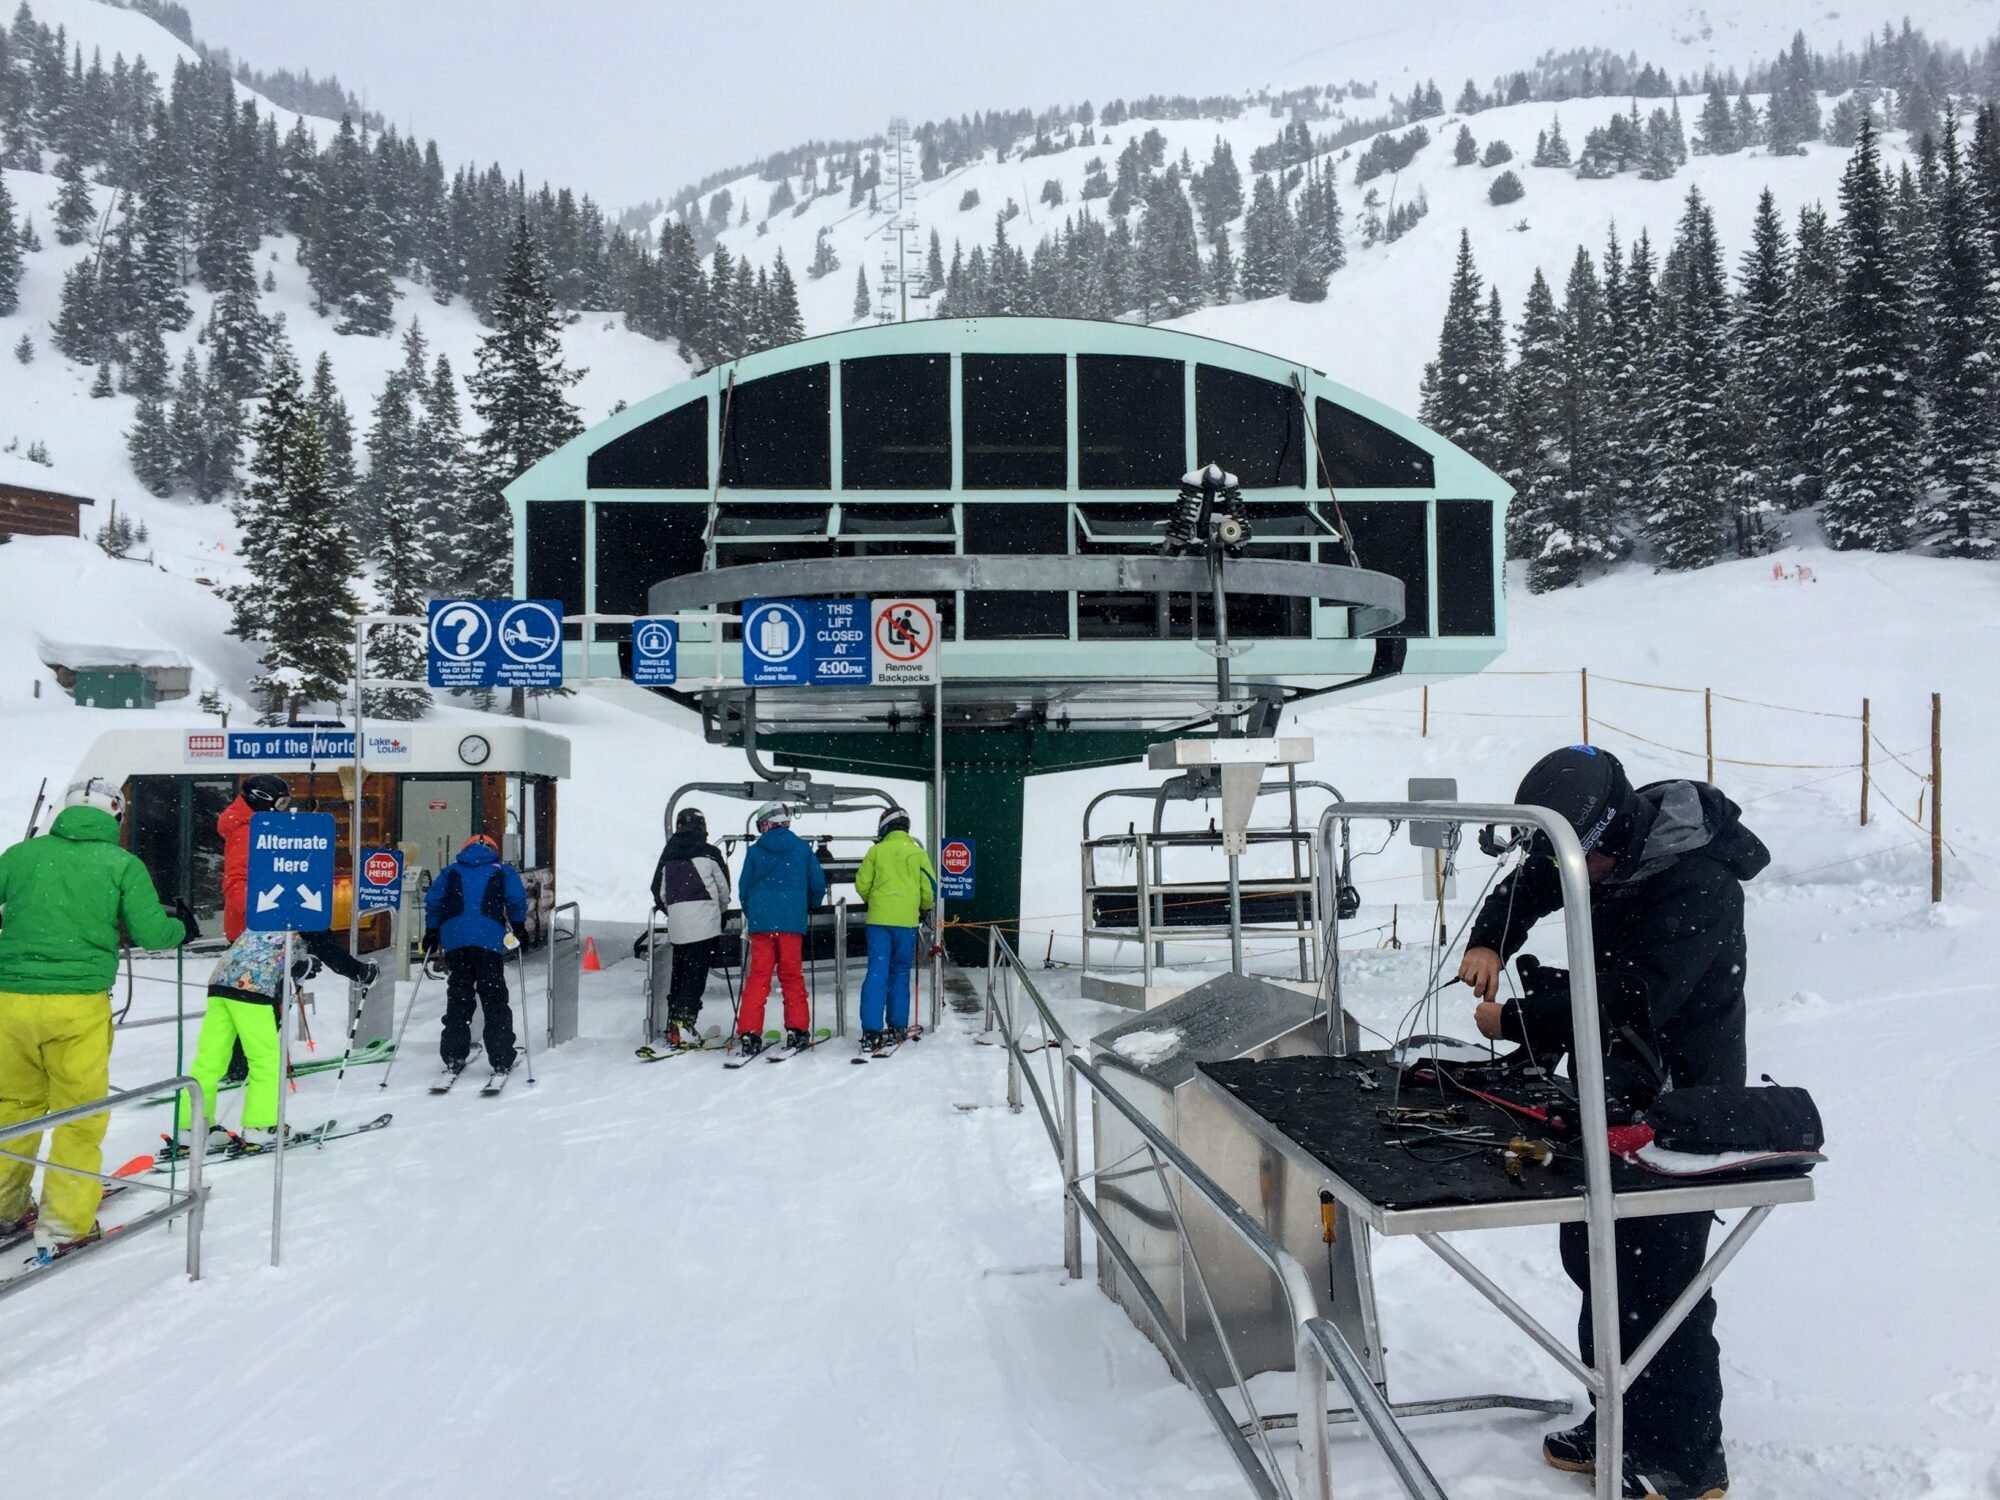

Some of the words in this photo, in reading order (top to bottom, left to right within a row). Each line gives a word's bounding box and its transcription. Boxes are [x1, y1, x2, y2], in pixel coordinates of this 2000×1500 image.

[827, 604, 854, 616] THIS
[828, 617, 852, 628] LIFT
[816, 630, 863, 642] CLOSED
[833, 644, 847, 655] AT
[763, 665, 788, 673] Secure
[885, 663, 923, 672] Remove
[754, 673, 777, 682] Loose
[777, 673, 797, 682] Items
[878, 673, 930, 684] Backpacks
[369, 738, 390, 747] Lake
[233, 739, 261, 757] Top
[265, 739, 280, 754] of
[284, 739, 309, 754] the
[313, 738, 356, 754] World
[377, 745, 408, 754] Louise
[256, 834, 328, 850] Alternate
[946, 850, 968, 858] STOP
[273, 857, 309, 873] Here
[370, 860, 394, 868] STOP
[946, 858, 966, 866] HERE
[368, 869, 394, 878] HERE
[359, 886, 381, 895] Follow
[381, 888, 400, 896] Chair
[360, 894, 388, 902] Forward
[389, 895, 398, 903] To
